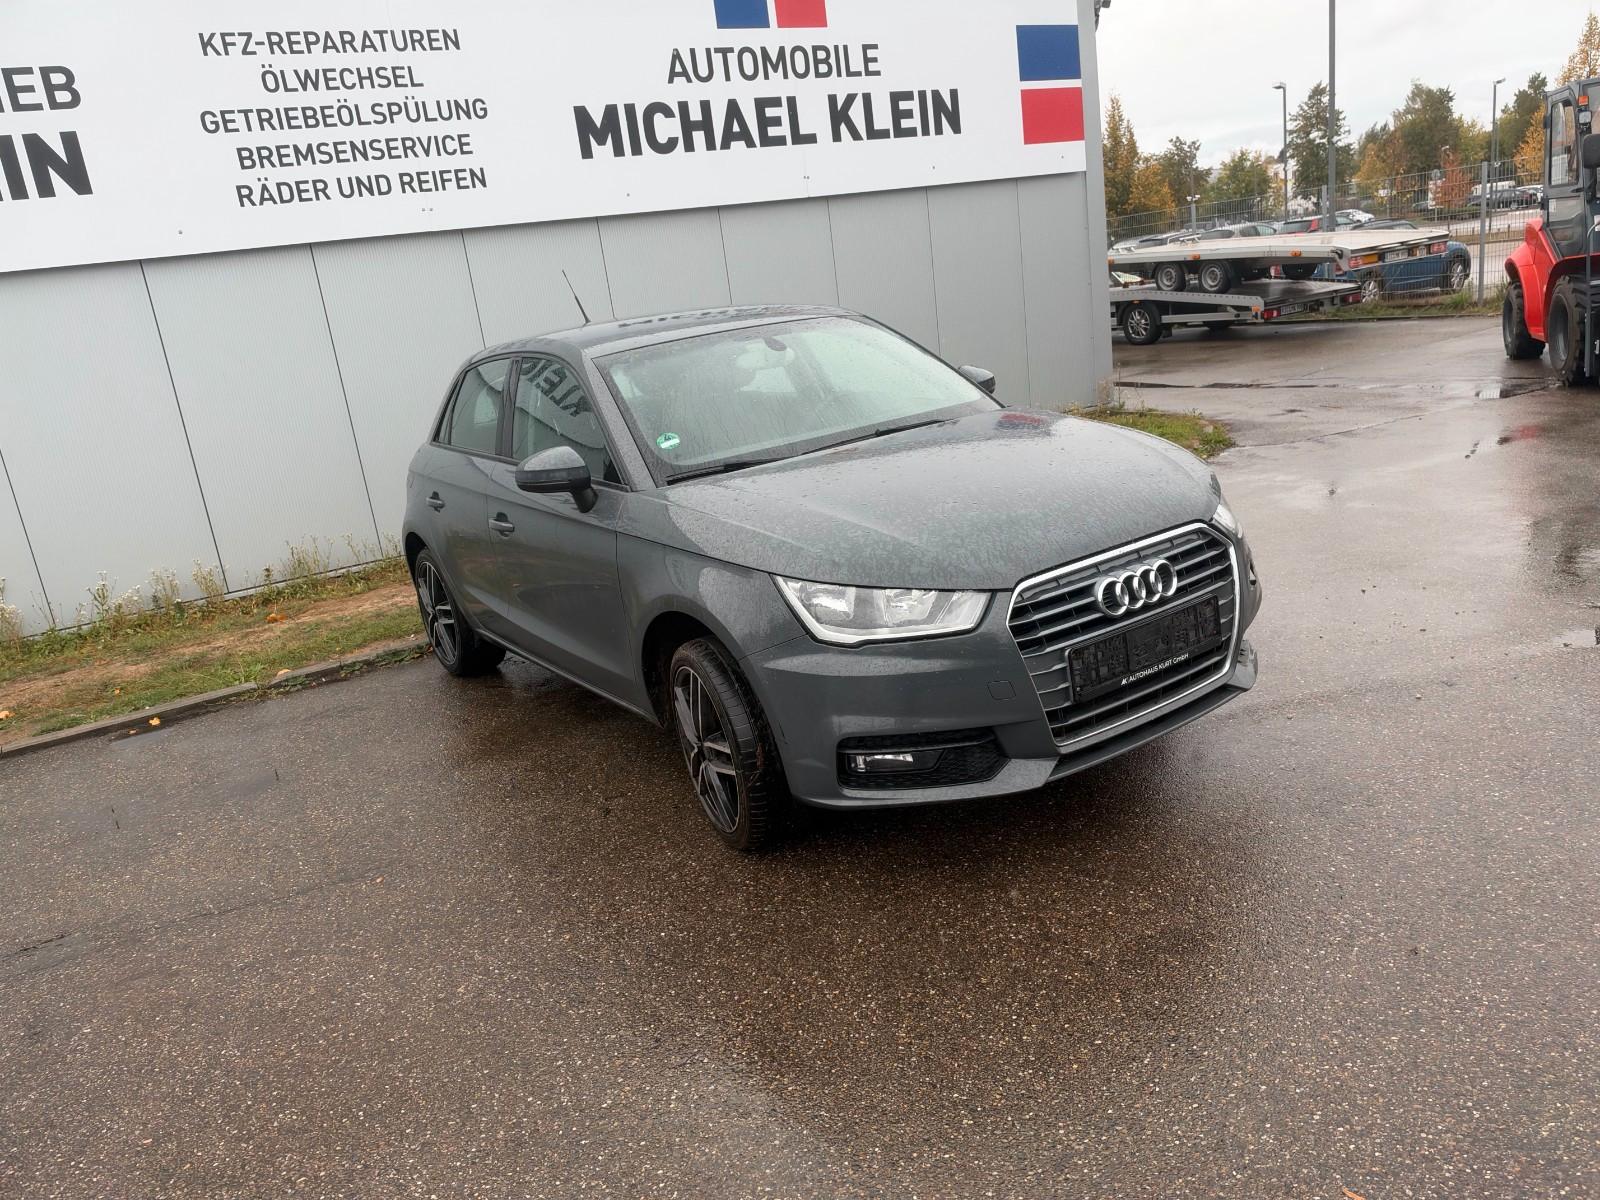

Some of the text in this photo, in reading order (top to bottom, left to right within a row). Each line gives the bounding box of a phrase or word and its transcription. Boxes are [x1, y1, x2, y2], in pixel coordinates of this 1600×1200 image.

[199, 28, 461, 57] KFZ-REPARATUREN
[260, 64, 424, 94] ÖLWECHSEL
[667, 43, 882, 84] AUTOMOBILE
[0, 65, 82, 113] EB
[199, 97, 489, 135] GETRIEBEÖLSPÜLUNG
[572, 88, 962, 160] MICHAEL KLEIN
[0, 130, 94, 201] IN
[235, 133, 474, 171] BREMSENSERVICE
[235, 167, 488, 208] RÄDER UND REIFEN
[1129, 665, 1158, 683] AUTOHAUS
[1159, 659, 1172, 670] KURT
[1173, 653, 1189, 664] GmbH
